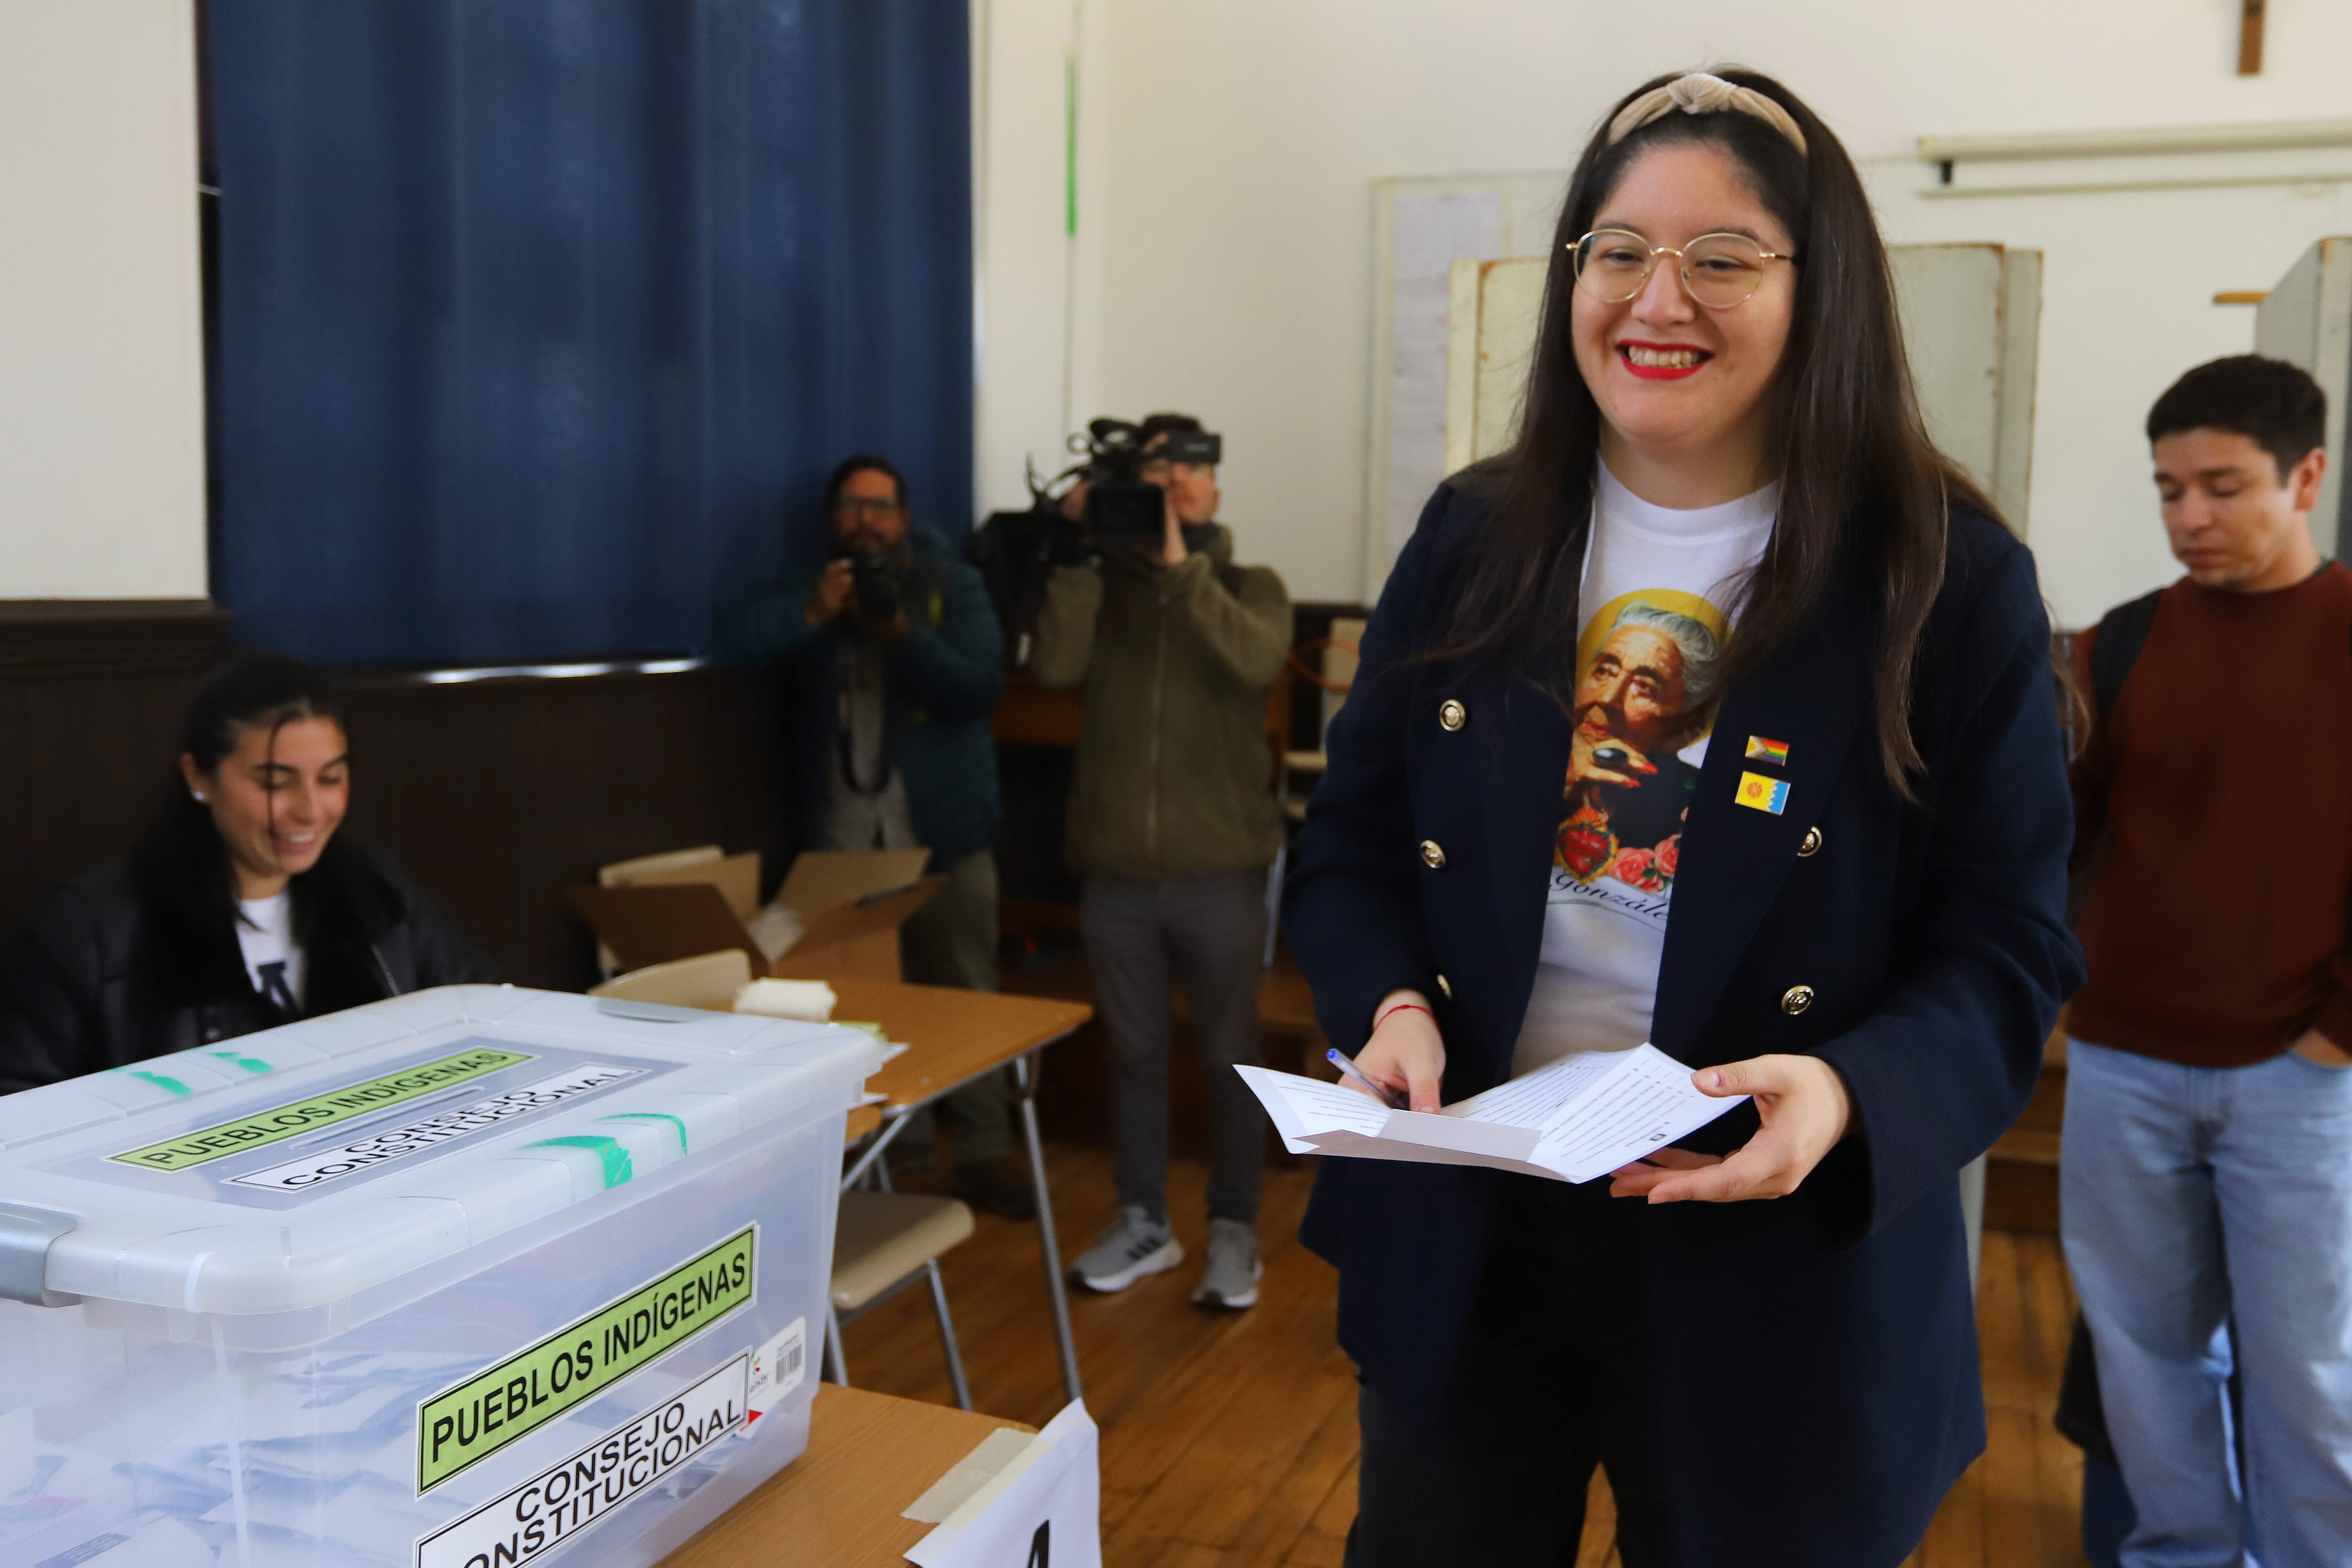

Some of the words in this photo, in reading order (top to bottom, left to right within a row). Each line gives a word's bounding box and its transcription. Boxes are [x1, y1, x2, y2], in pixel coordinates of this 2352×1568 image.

[142, 1106, 334, 1163] PUEBLOS
[328, 1052, 508, 1108] INDÍGENAS
[283, 1073, 620, 1185] CONSTITUCIONAL
[345, 1090, 536, 1154] CONSEJO
[432, 1339, 593, 1463] PUEBLOS
[604, 1252, 746, 1366] INDÍGENAS
[516, 1402, 684, 1522] CONSEJO
